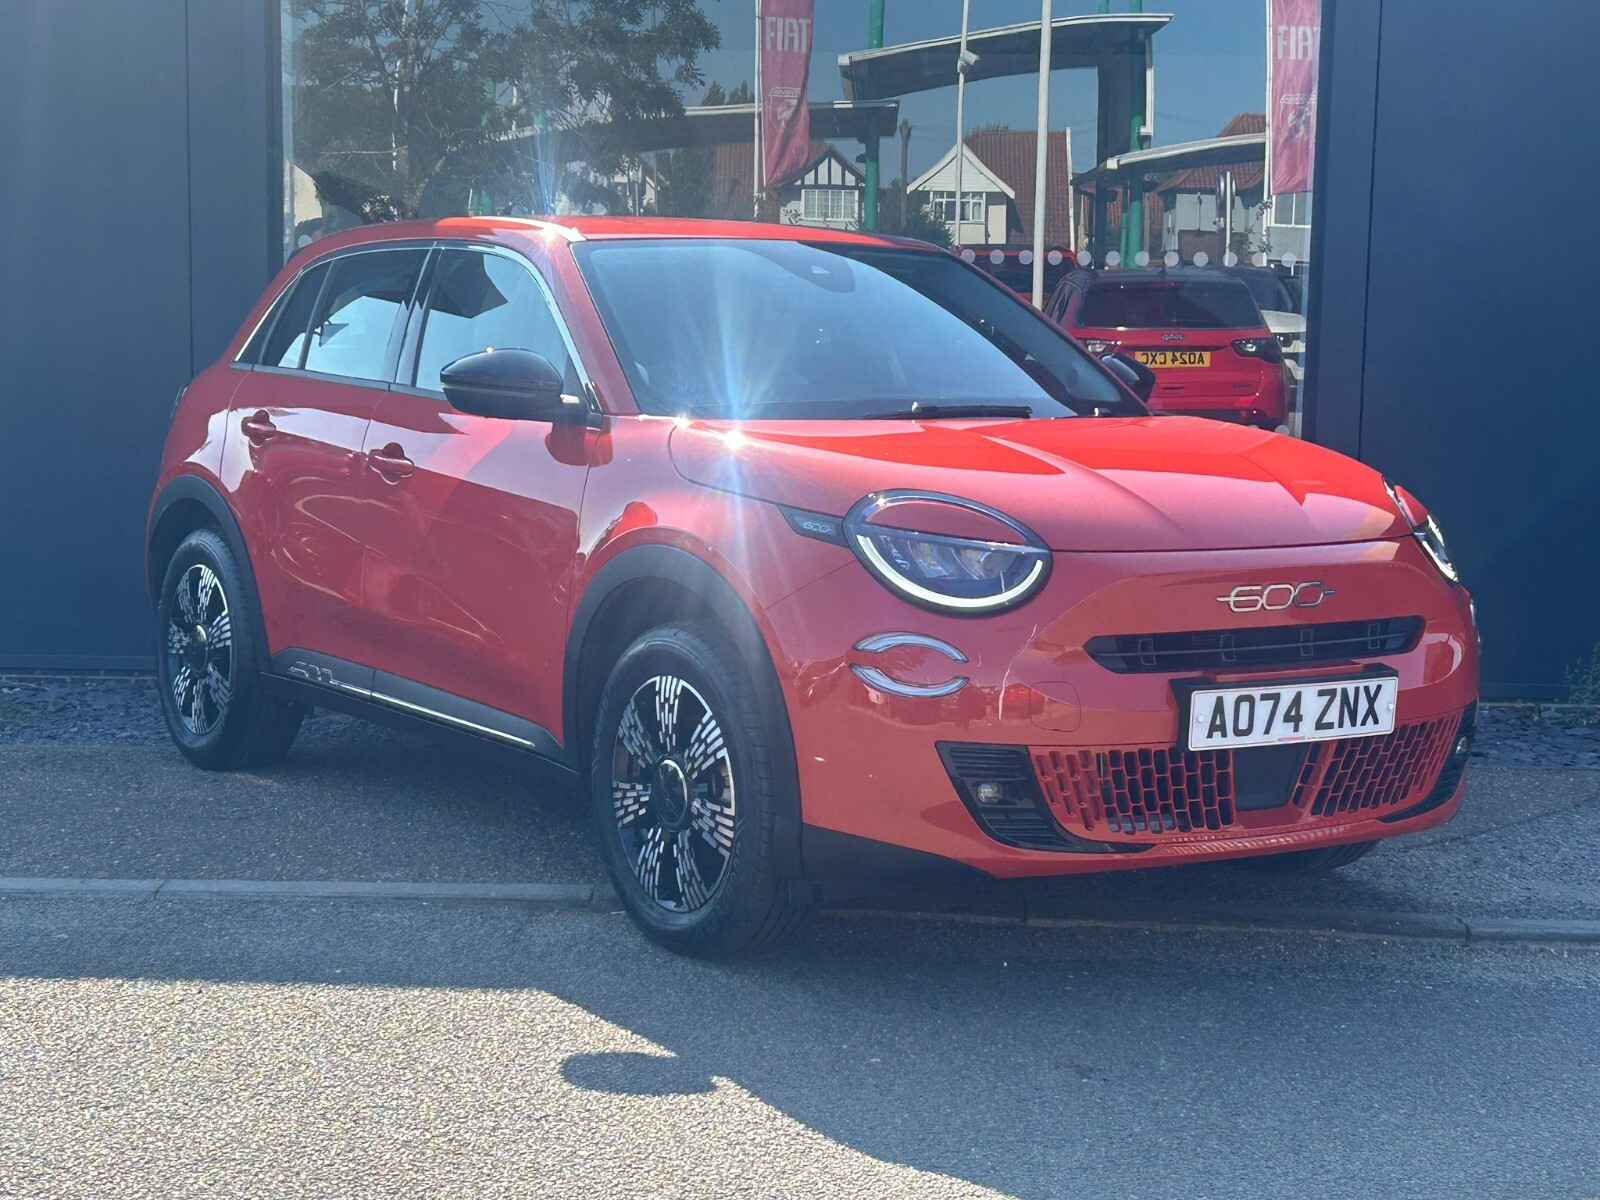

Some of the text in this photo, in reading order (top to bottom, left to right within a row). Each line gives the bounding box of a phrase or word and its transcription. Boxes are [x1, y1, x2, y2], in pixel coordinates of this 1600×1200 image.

[765, 16, 811, 52] FIAT
[1217, 581, 1335, 612] 600
[1206, 684, 1382, 739] AO74 ZNX
